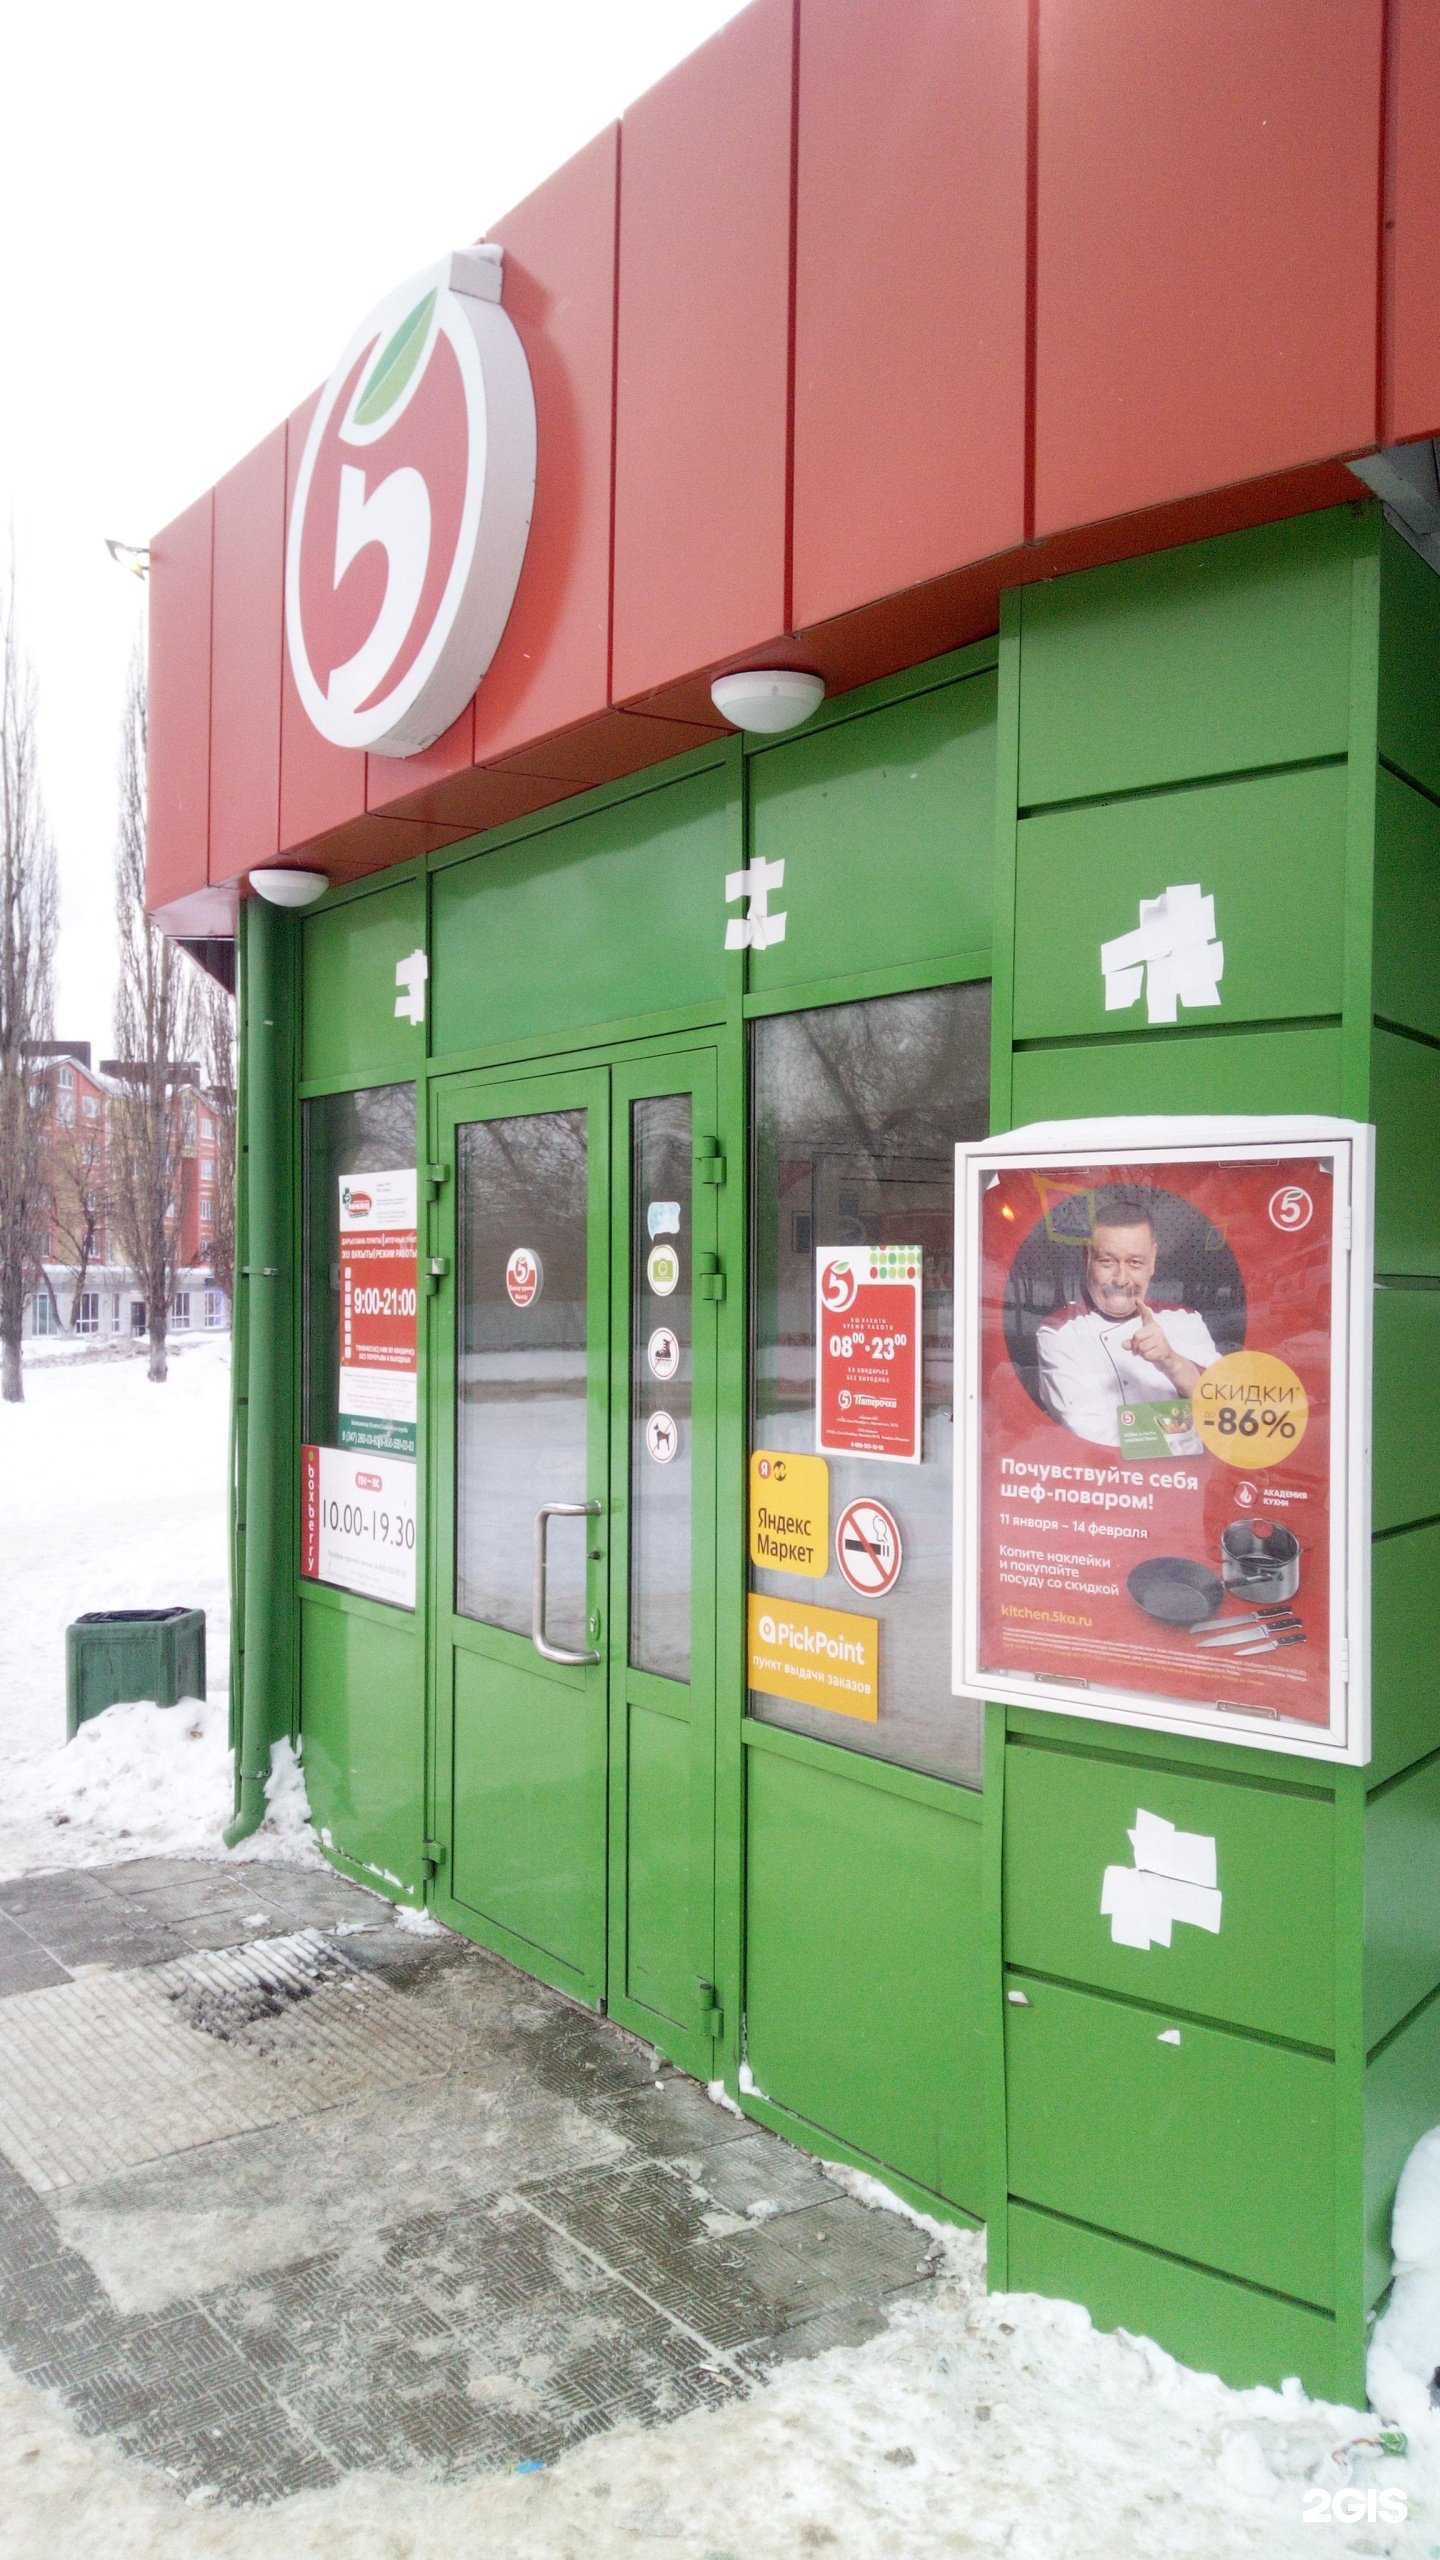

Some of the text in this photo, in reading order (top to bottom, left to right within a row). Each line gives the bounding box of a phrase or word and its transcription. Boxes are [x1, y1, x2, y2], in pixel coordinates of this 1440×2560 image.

[354, 1287, 416, 1316] 9:00-21:00
[1204, 1407, 1296, 1439] -86%
[1000, 1458, 1199, 1490] Почувствуйте себя
[1000, 1483, 1153, 1510] шеф-поваром!
[323, 1499, 415, 1550] 10.00-19.30
[758, 1507, 812, 1536] Яндекс
[1000, 1513, 1009, 1525] 11
[1012, 1516, 1059, 1531] января
[1072, 1520, 1085, 1533] 14
[1088, 1521, 1148, 1539] февраля
[757, 1533, 814, 1564] Маркет
[999, 1544, 1111, 1569] Копите наклейки
[1000, 1559, 1080, 1577] и покупайте
[1000, 1572, 1120, 1596] посуду со скидкой
[1001, 1604, 1093, 1627] kitchen.5ka.ru
[778, 1622, 865, 1666] PickPoint
[752, 1655, 872, 1695] пункт выдачи заказов
